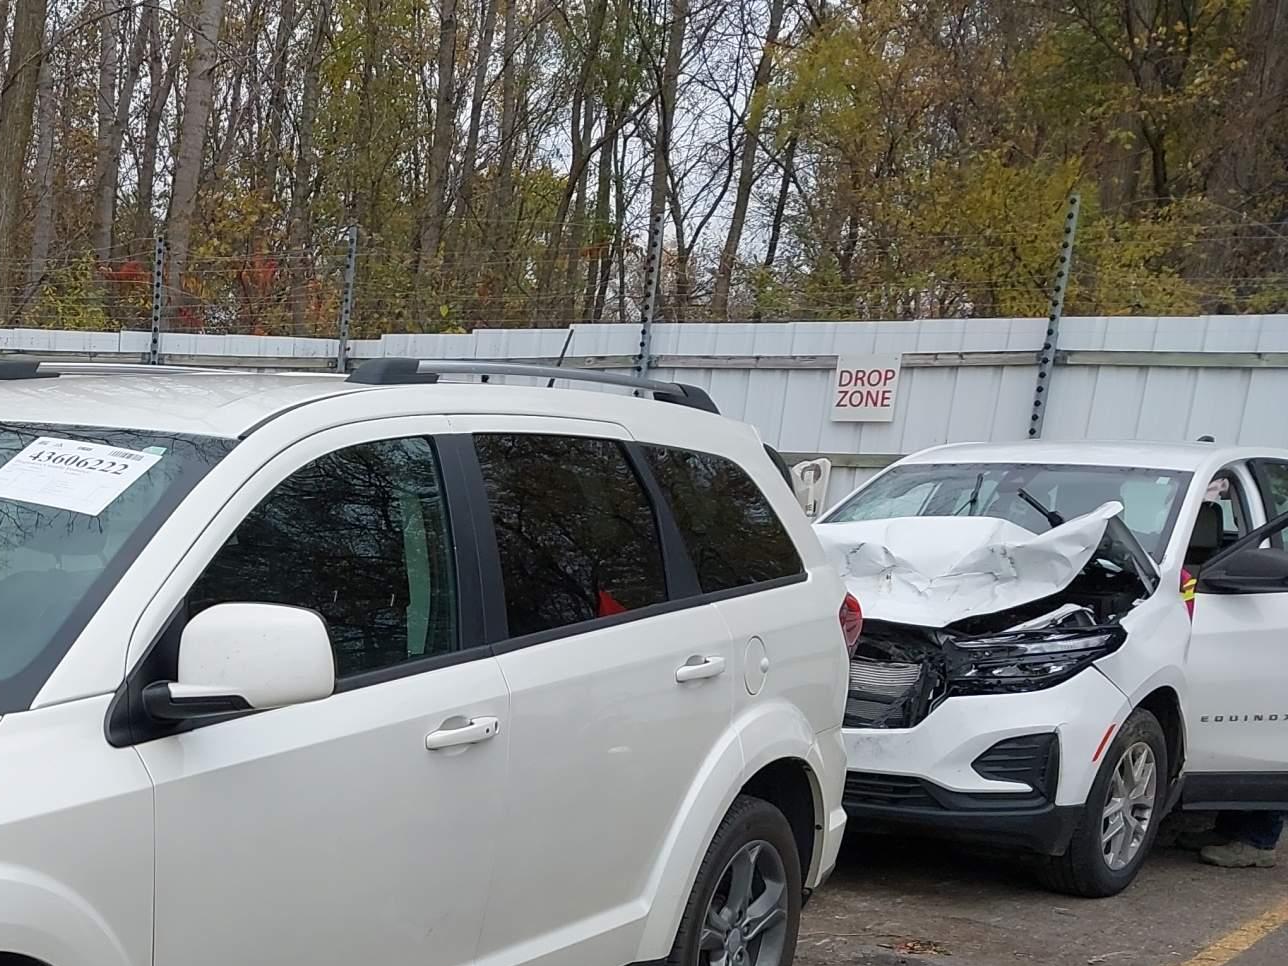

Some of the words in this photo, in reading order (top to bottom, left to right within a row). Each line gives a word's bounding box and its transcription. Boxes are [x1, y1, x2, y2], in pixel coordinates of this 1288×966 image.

[838, 369, 896, 387] DROP
[835, 390, 892, 407] ZONE
[29, 450, 129, 475] 43606222
